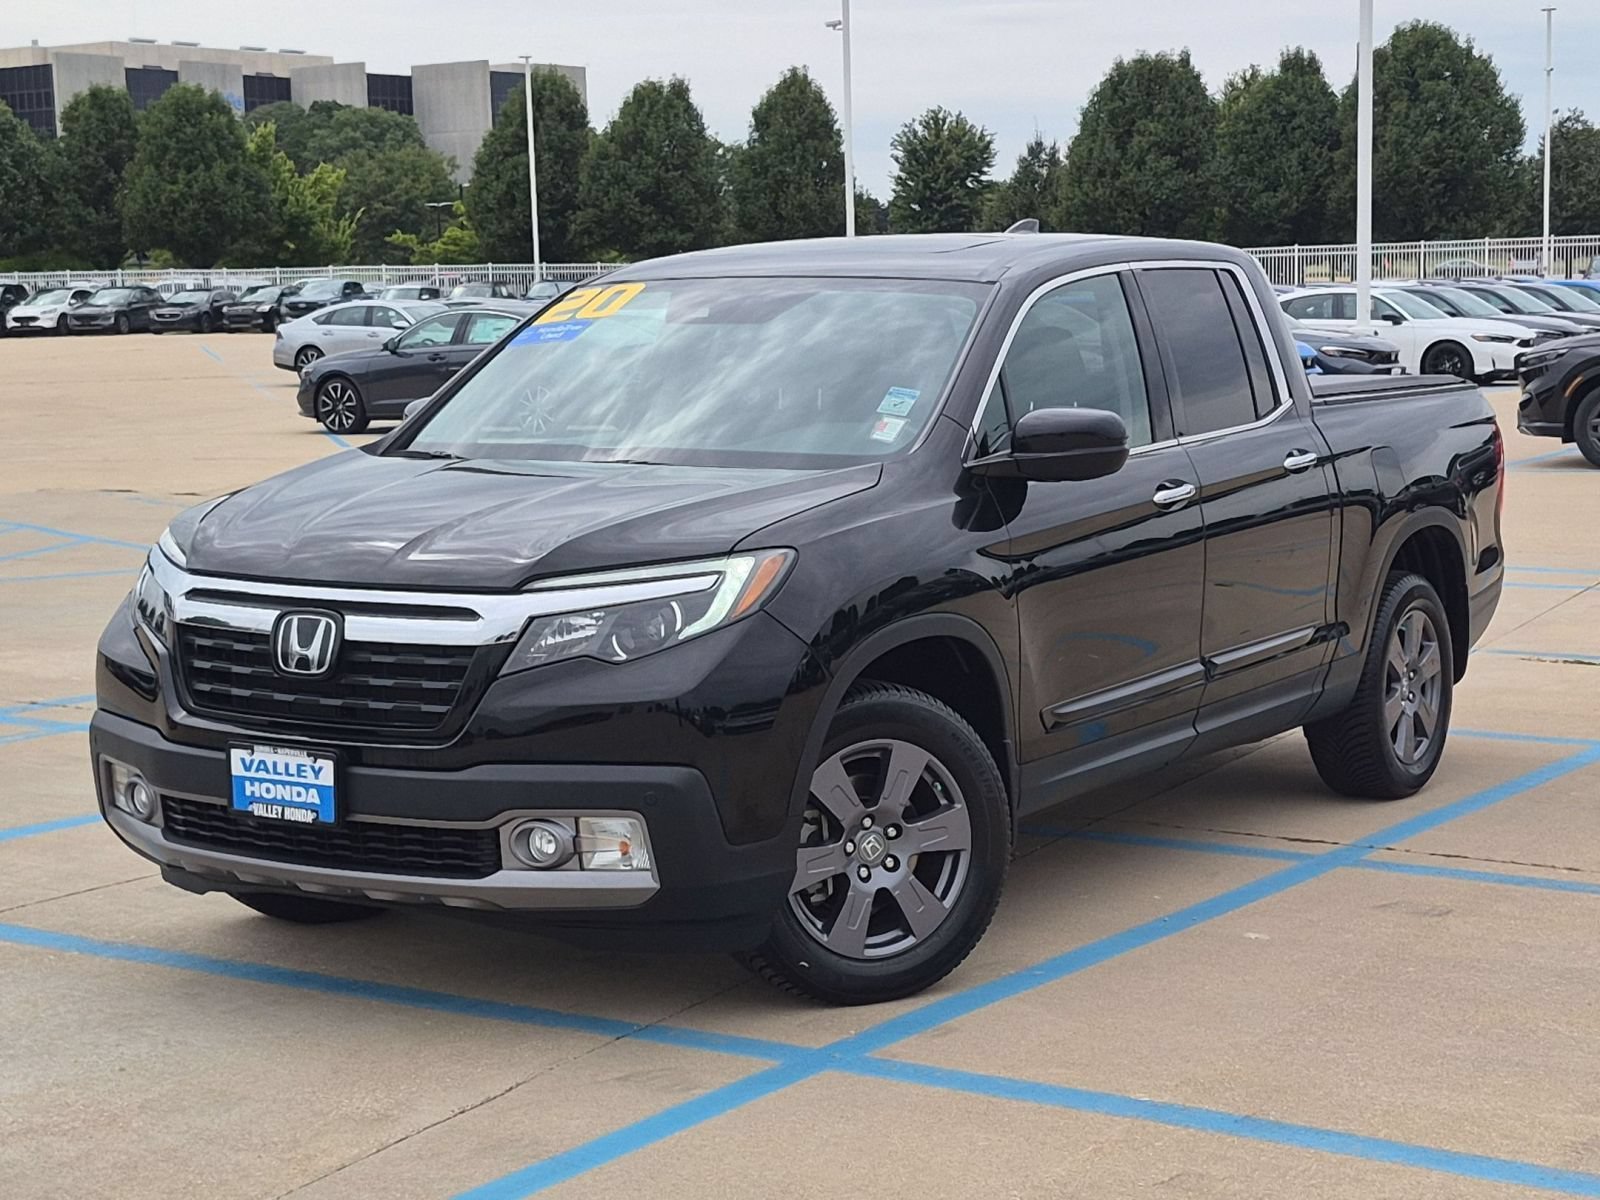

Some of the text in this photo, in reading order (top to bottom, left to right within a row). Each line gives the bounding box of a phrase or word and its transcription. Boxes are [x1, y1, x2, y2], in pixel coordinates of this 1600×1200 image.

[534, 283, 646, 324] 20
[240, 757, 323, 780] VALLEY
[245, 780, 320, 804] HONDA
[252, 802, 315, 824] VALLEY HONDA
